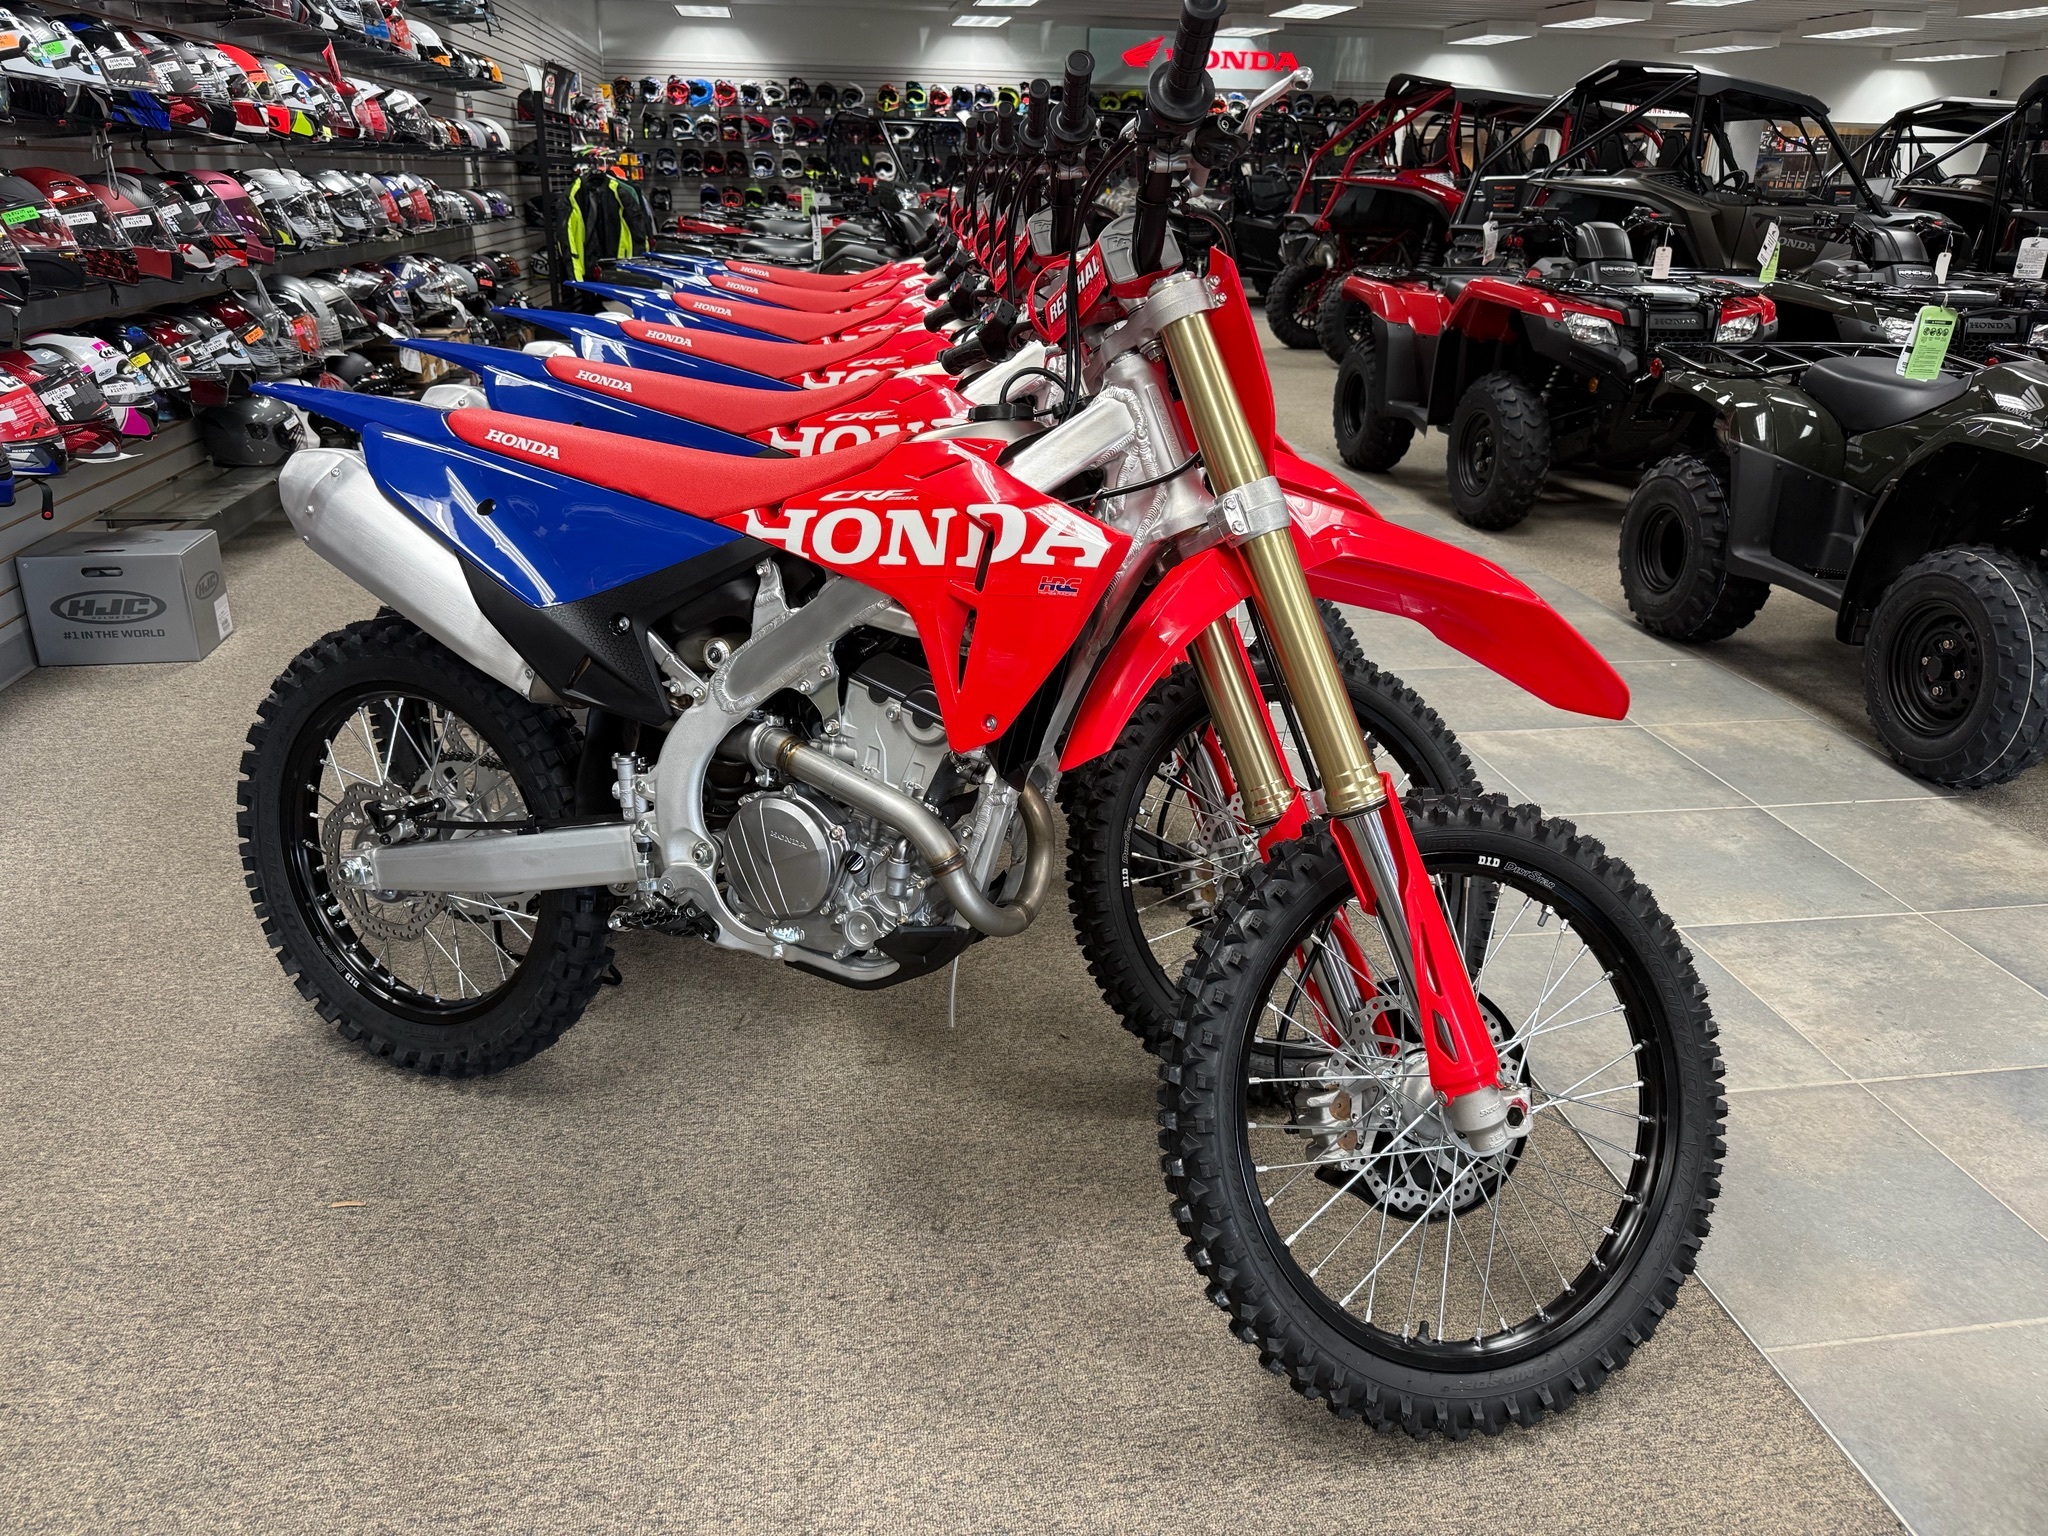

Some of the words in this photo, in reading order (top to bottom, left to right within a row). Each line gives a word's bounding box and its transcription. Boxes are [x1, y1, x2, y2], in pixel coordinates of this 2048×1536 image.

[1778, 236, 1817, 253] ONDA
[740, 266, 770, 278] HONDA
[726, 281, 759, 295] HONDA
[693, 301, 733, 317] HONDA
[1969, 321, 2013, 331] HONDA
[645, 329, 693, 348] HONDA
[847, 356, 903, 368] CRF
[575, 369, 633, 393] HONDA
[825, 409, 896, 422] CRF
[2000, 404, 2033, 420] HONDA
[484, 428, 560, 460] HONDA
[818, 488, 913, 502] CRF
[741, 503, 1111, 568] HONDA
[199, 574, 217, 597] HJC
[1038, 575, 1082, 593] HRC
[67, 598, 151, 617] HJC
[63, 631, 80, 640] #1
[81, 630, 94, 639] IN
[94, 630, 119, 639] THE
[120, 628, 166, 638] WORLD
[770, 831, 808, 850] HONDA
